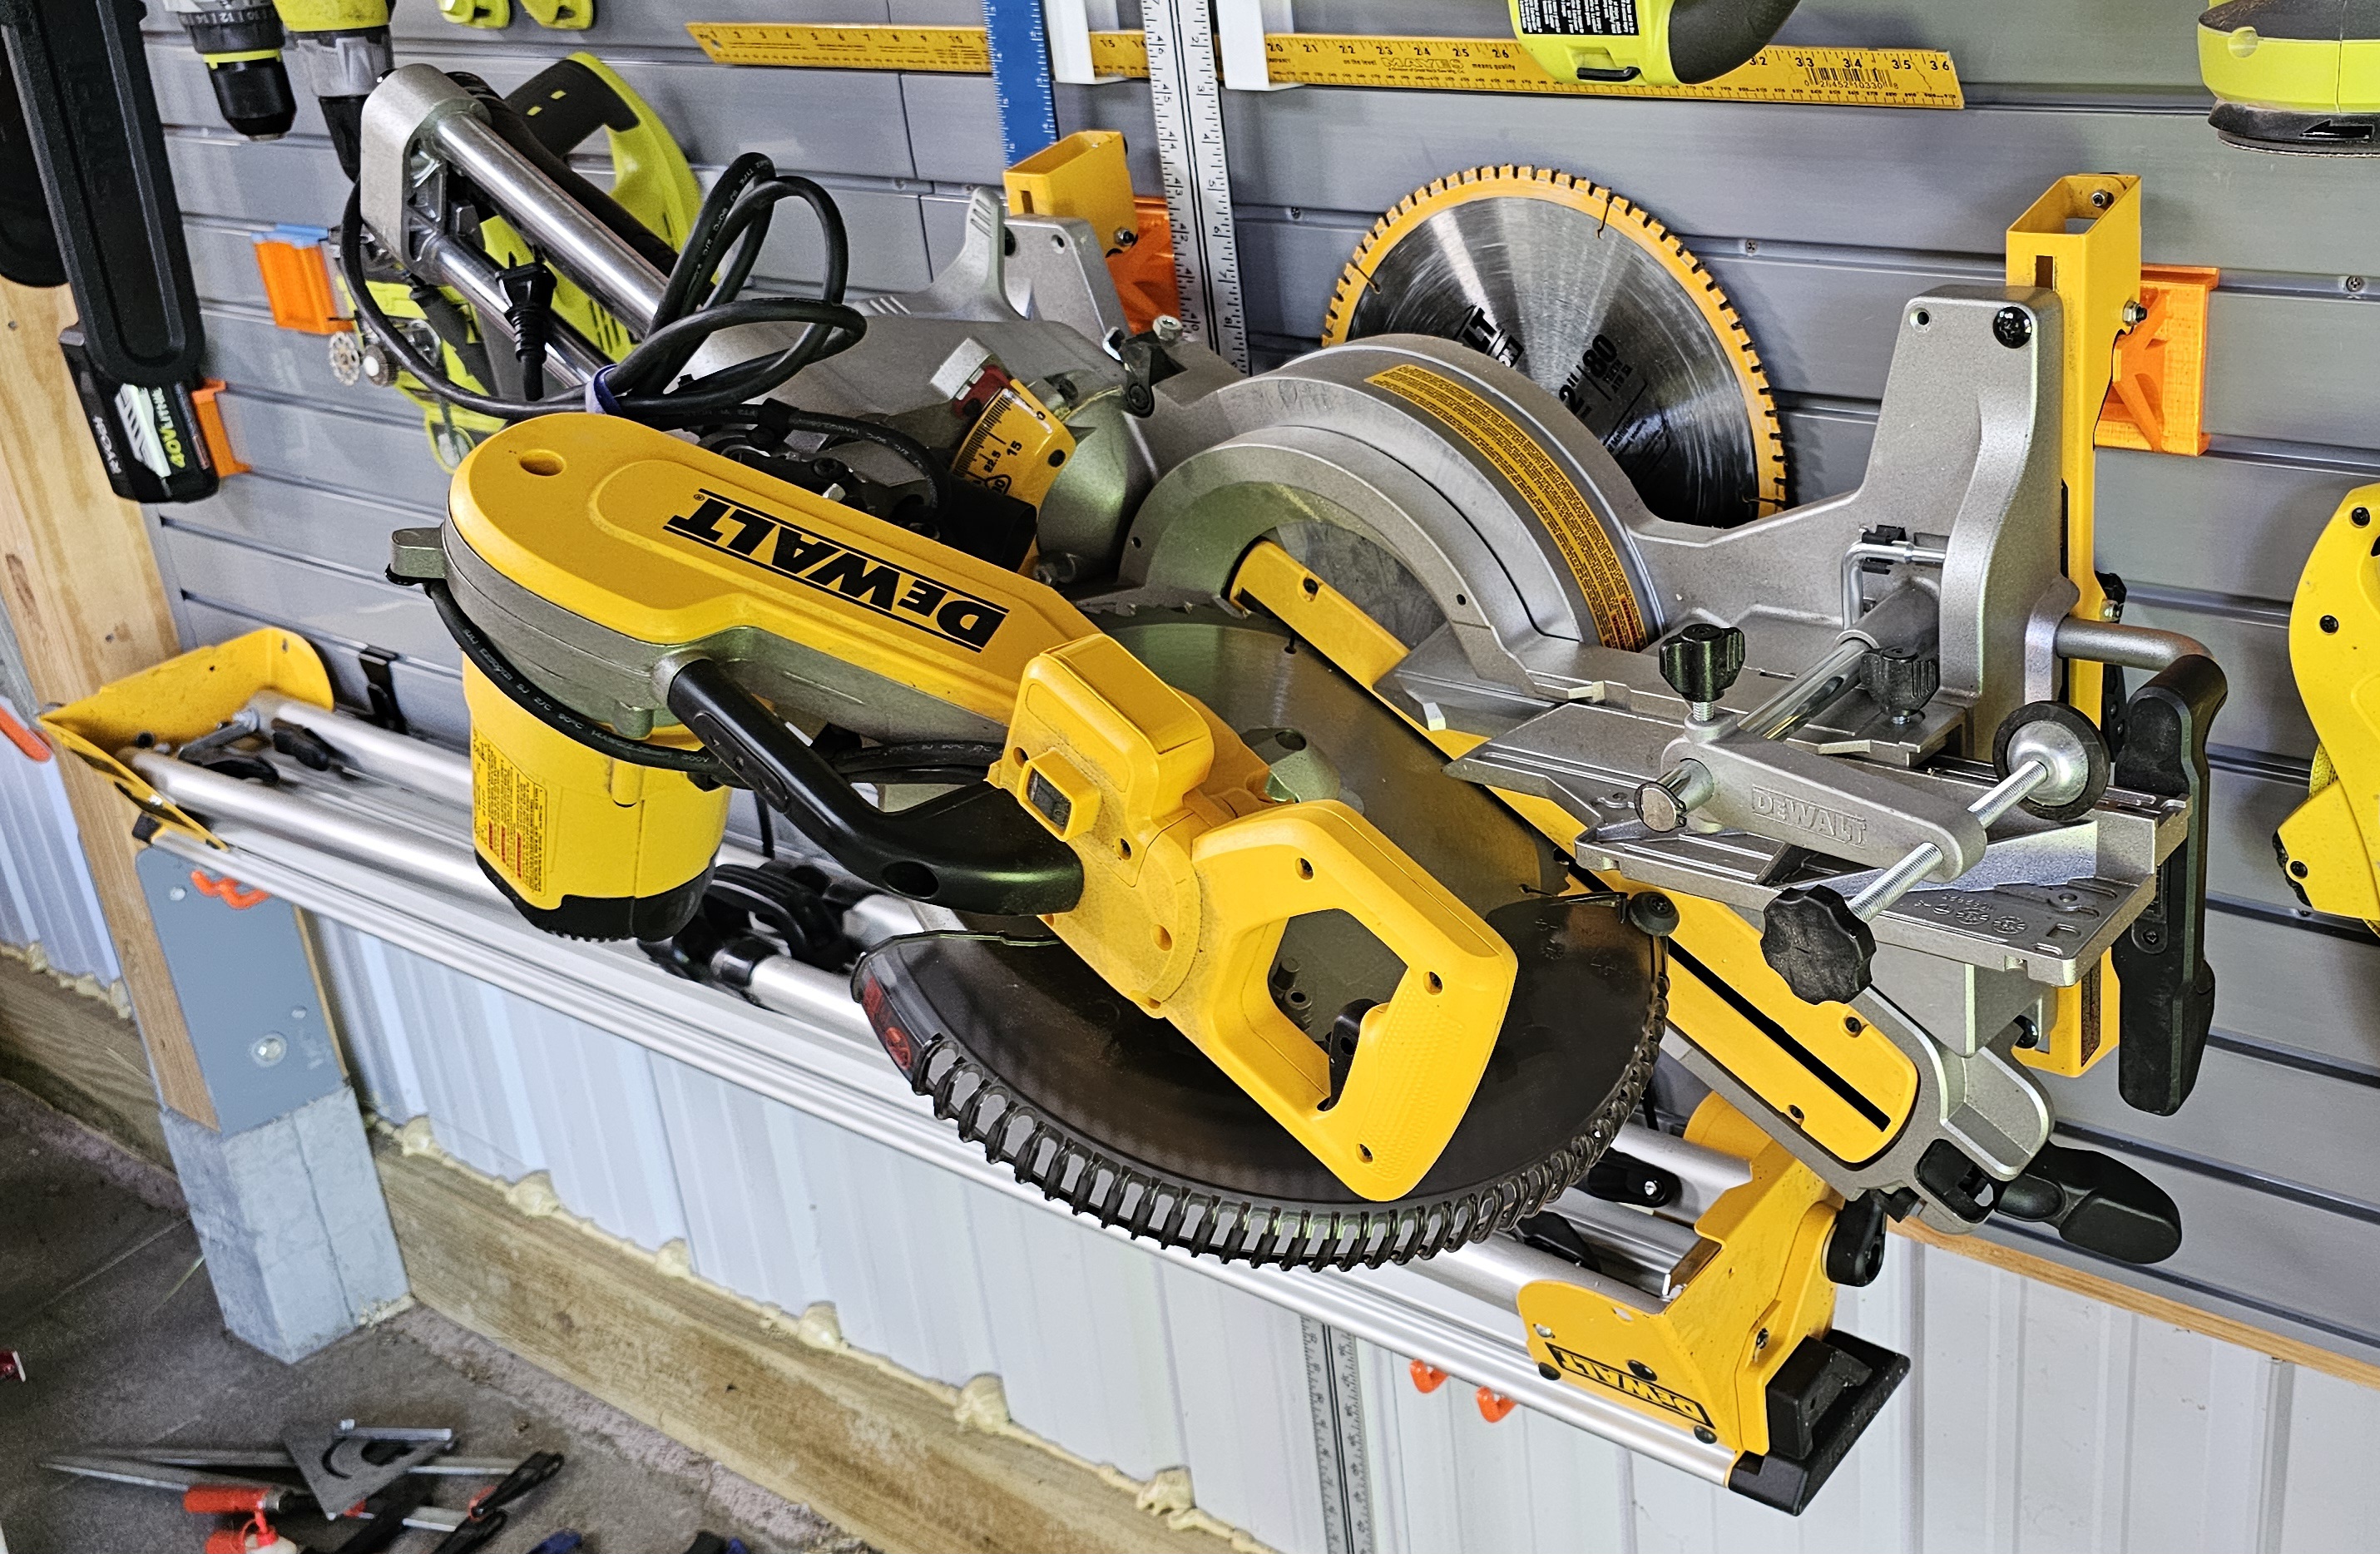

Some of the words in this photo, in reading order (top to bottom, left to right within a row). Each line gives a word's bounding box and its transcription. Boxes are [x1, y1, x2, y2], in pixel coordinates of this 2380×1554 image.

[1267, 43, 1284, 52] 20
[1303, 44, 1319, 53] 21
[1338, 45, 1356, 54] 22
[1376, 46, 1393, 55] 23
[1414, 47, 1431, 56] 24
[1452, 47, 1470, 57] 25
[1492, 48, 1510, 58] 26
[1749, 57, 1768, 66] 32
[1795, 57, 1814, 67] 33
[1843, 58, 1863, 68] 34
[1892, 59, 1912, 70] 35
[1931, 60, 1950, 71] 36
[1381, 57, 1464, 70] MAYES
[1582, 334, 1618, 379] 80
[1036, 410, 1047, 421] 0
[92, 416, 122, 475] RYOBI
[983, 450, 1002, 473] 22.5
[1006, 440, 1023, 457] 15
[668, 497, 1007, 649] DEWALT
[1751, 787, 1868, 846] DEWALT
[1560, 1350, 1707, 1425] DEWALT
